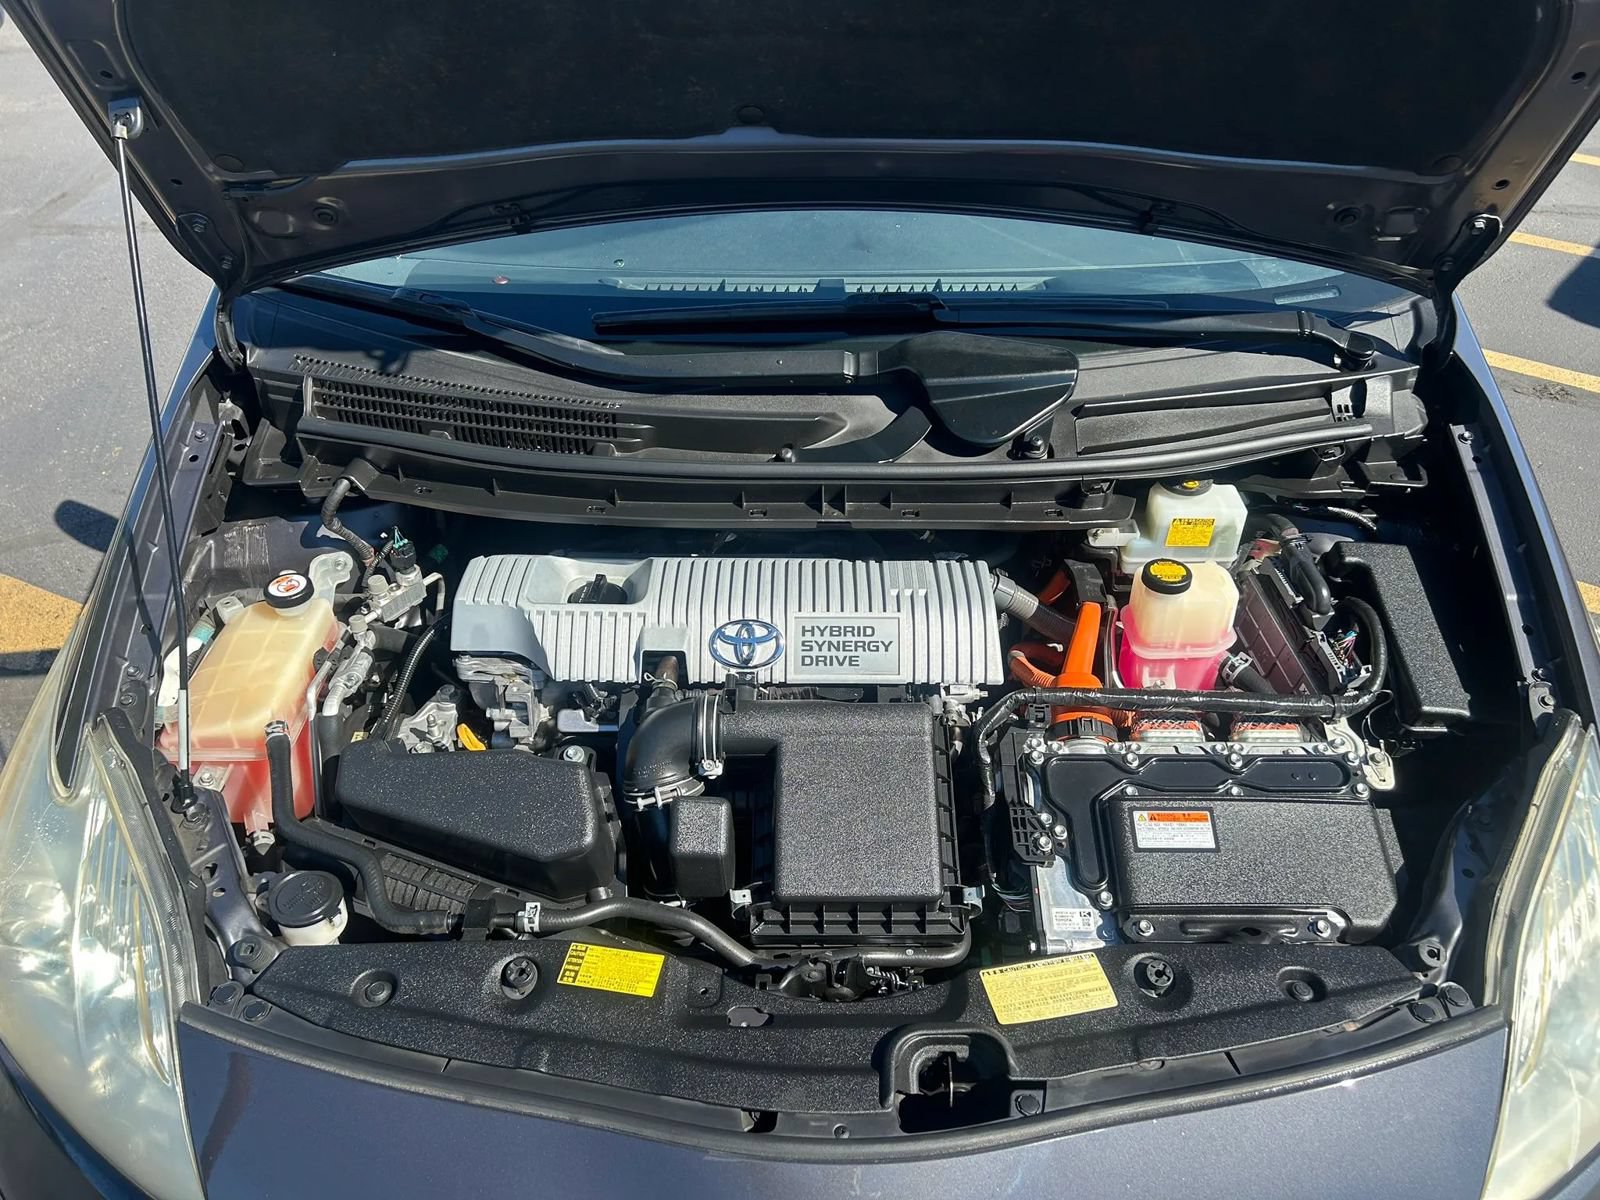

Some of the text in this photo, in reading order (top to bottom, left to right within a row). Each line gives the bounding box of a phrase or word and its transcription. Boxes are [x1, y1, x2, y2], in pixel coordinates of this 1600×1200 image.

[801, 625, 876, 637] HYBRID
[801, 640, 893, 652] SYNERGY
[801, 655, 860, 667] DRIVE
